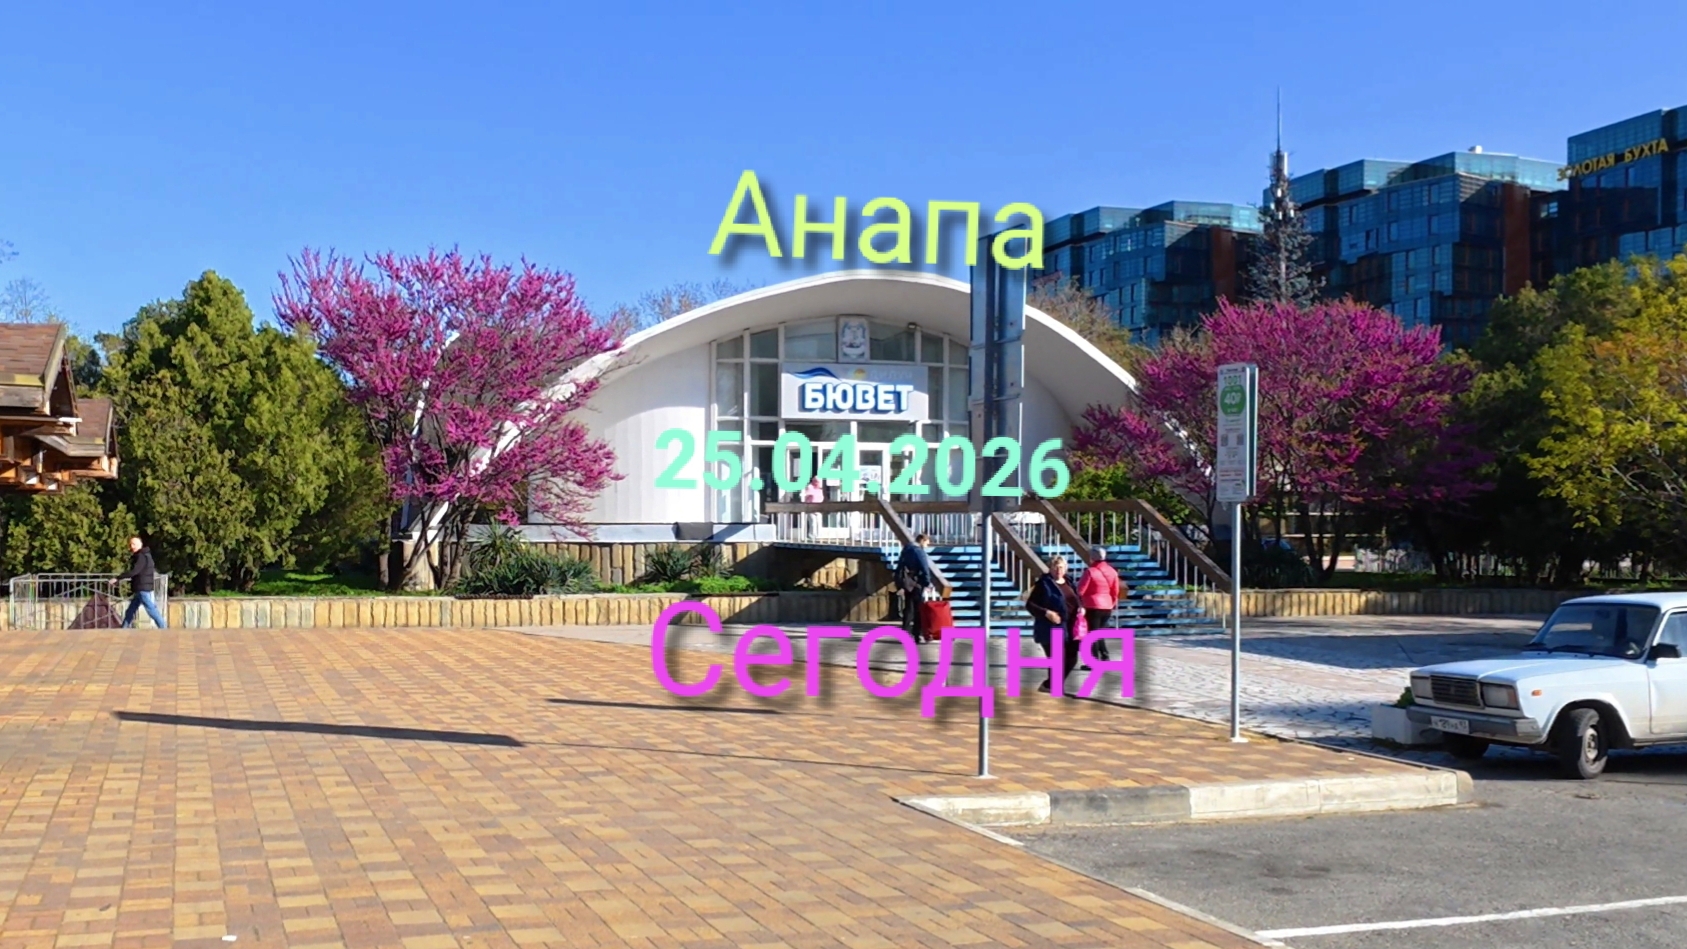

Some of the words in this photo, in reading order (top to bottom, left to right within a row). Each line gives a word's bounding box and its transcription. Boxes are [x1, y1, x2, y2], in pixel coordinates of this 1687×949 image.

[1556, 153, 1616, 182] ЗОЛОТАЯ
[1624, 138, 1668, 162] БУХТА
[799, 382, 914, 414] БЮВЕТ
